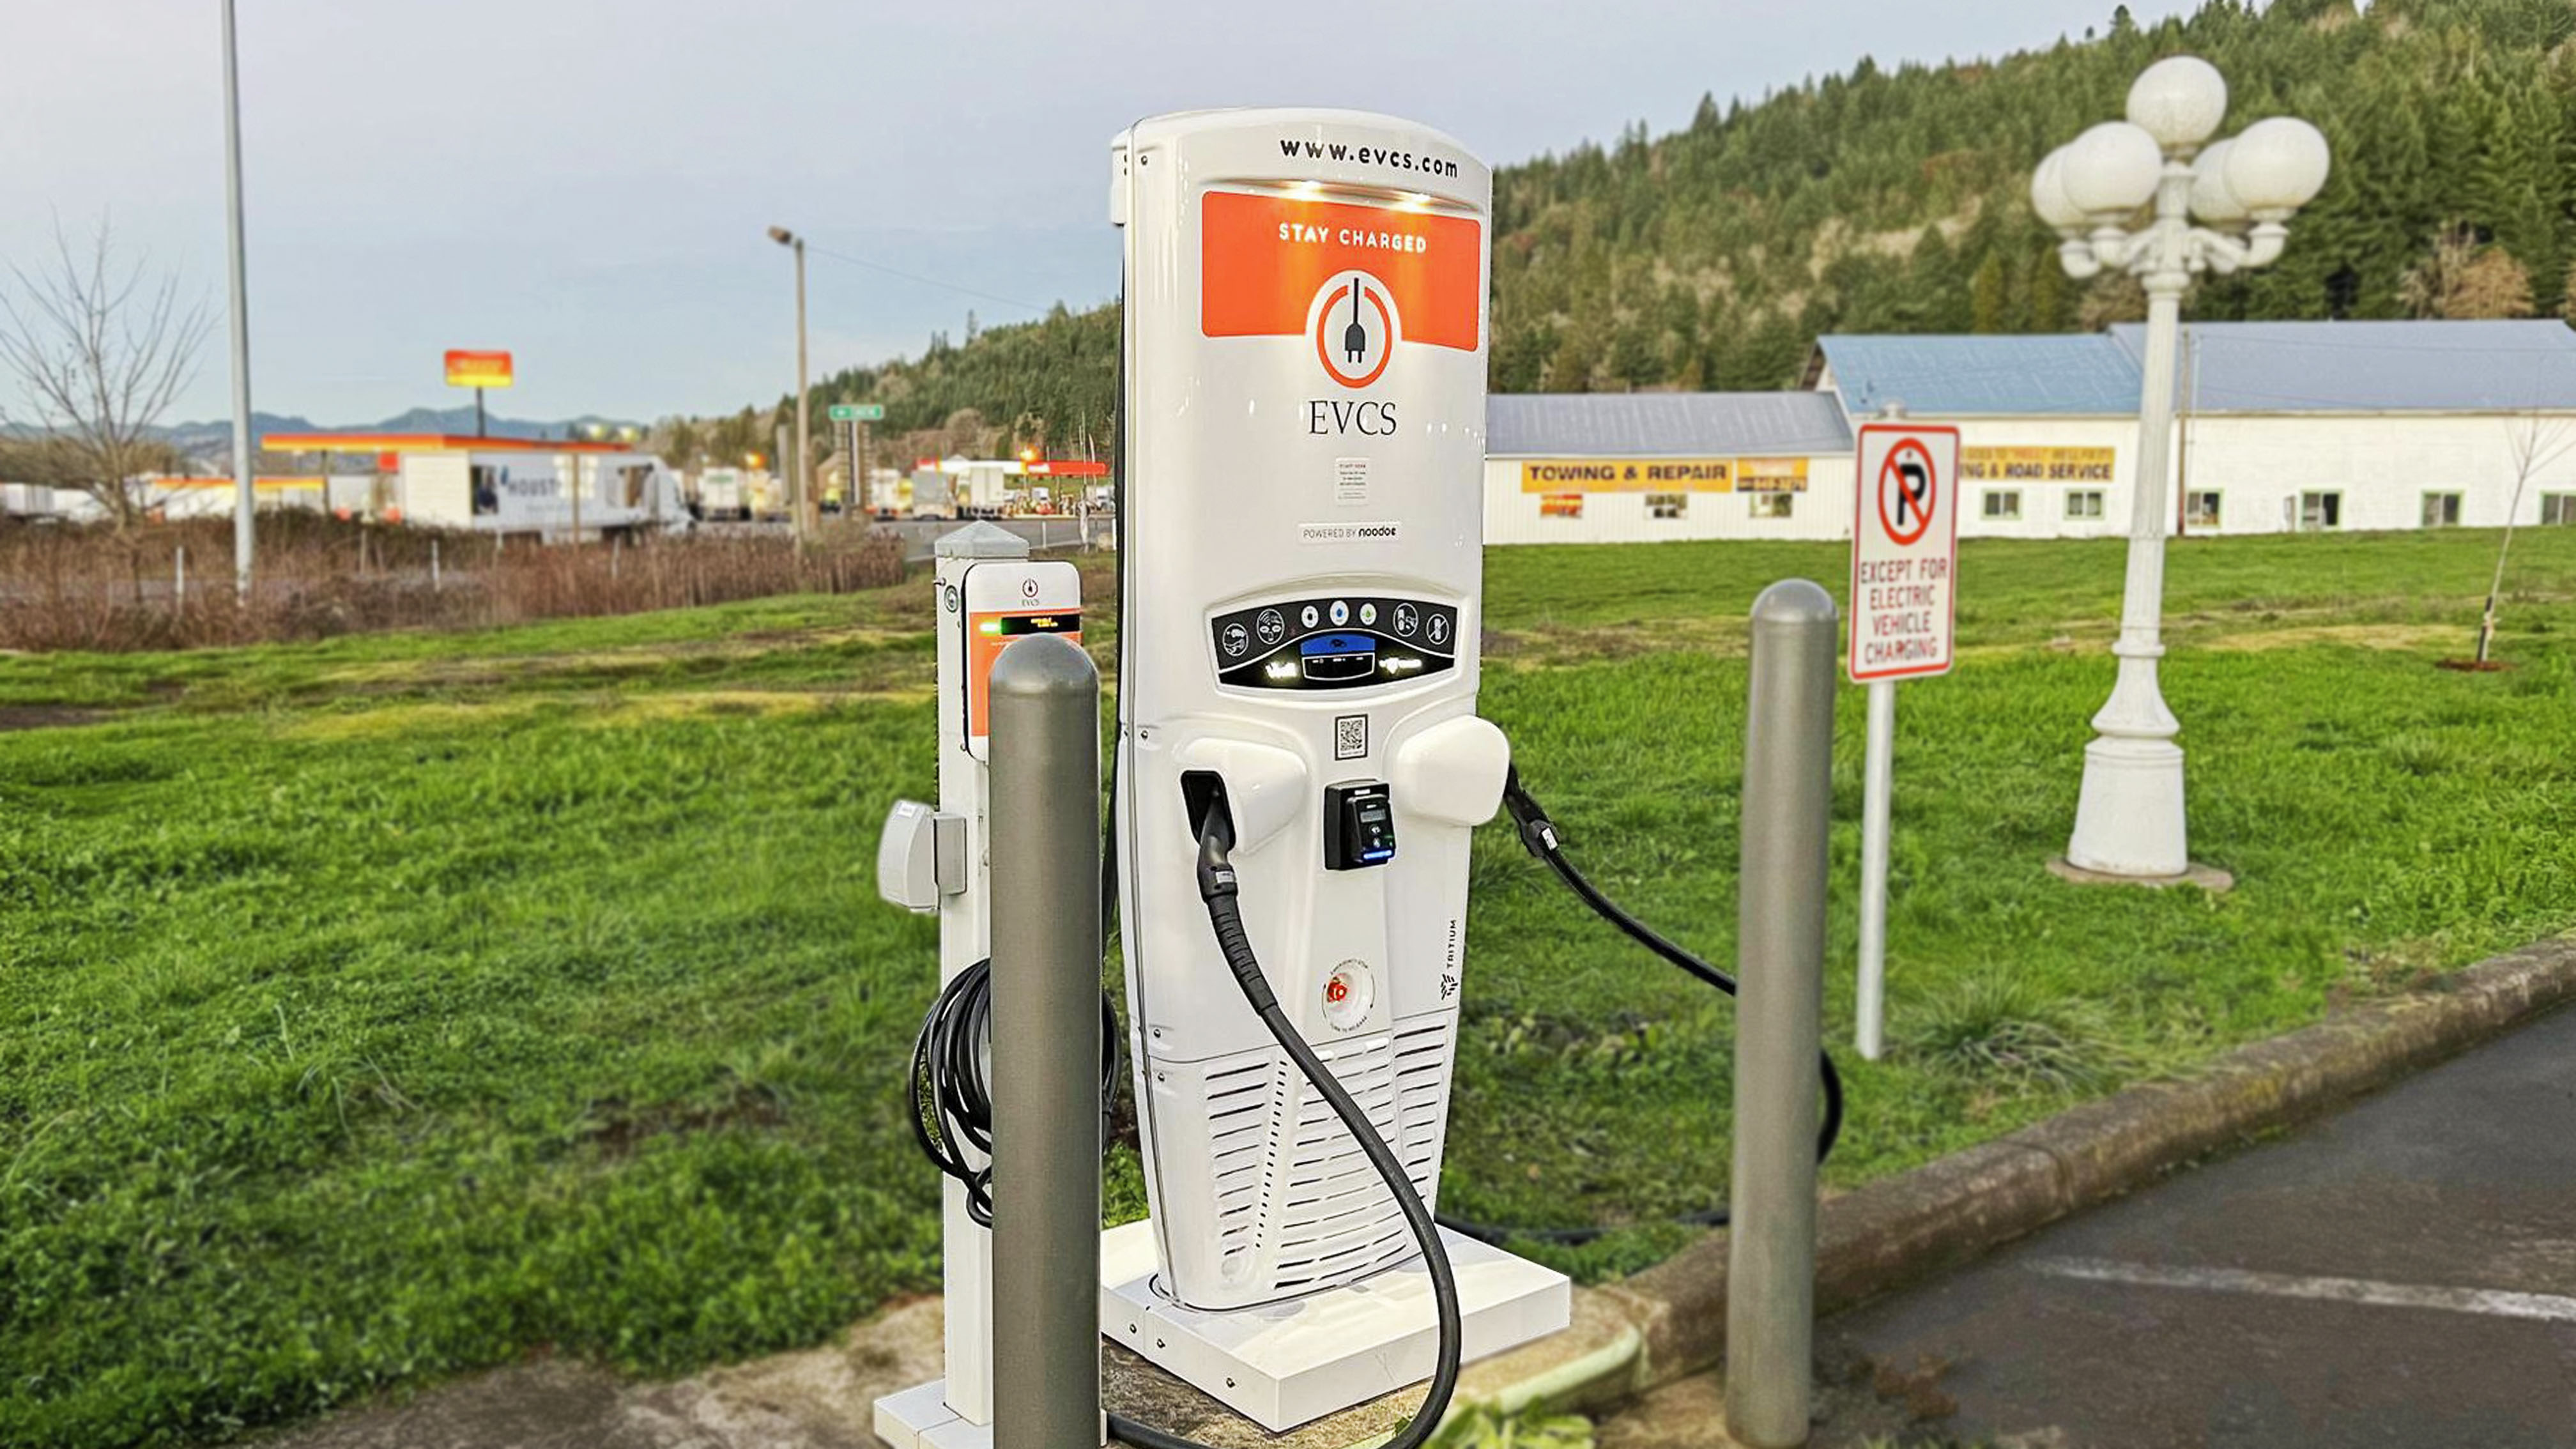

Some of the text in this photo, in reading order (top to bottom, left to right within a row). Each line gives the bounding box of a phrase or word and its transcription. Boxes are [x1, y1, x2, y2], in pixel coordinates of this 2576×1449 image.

[1280, 140, 1457, 178] www.evcs.com
[1279, 224, 1427, 253] STAY CHARGED
[1309, 401, 1397, 435] EVCS
[1530, 465, 1727, 480] TOWING & REPAIR
[1960, 463, 2110, 479] ING & ROAD SERVICE
[1303, 526, 1396, 539] POWERED BY noodoe
[1861, 558, 1947, 583] EXCEPT FOR
[1870, 585, 1935, 610] ELECTRIC
[1873, 611, 1931, 636] VEHICLE
[1866, 638, 1937, 664] CHARGING
[1446, 919, 1457, 969] TRITIUM
